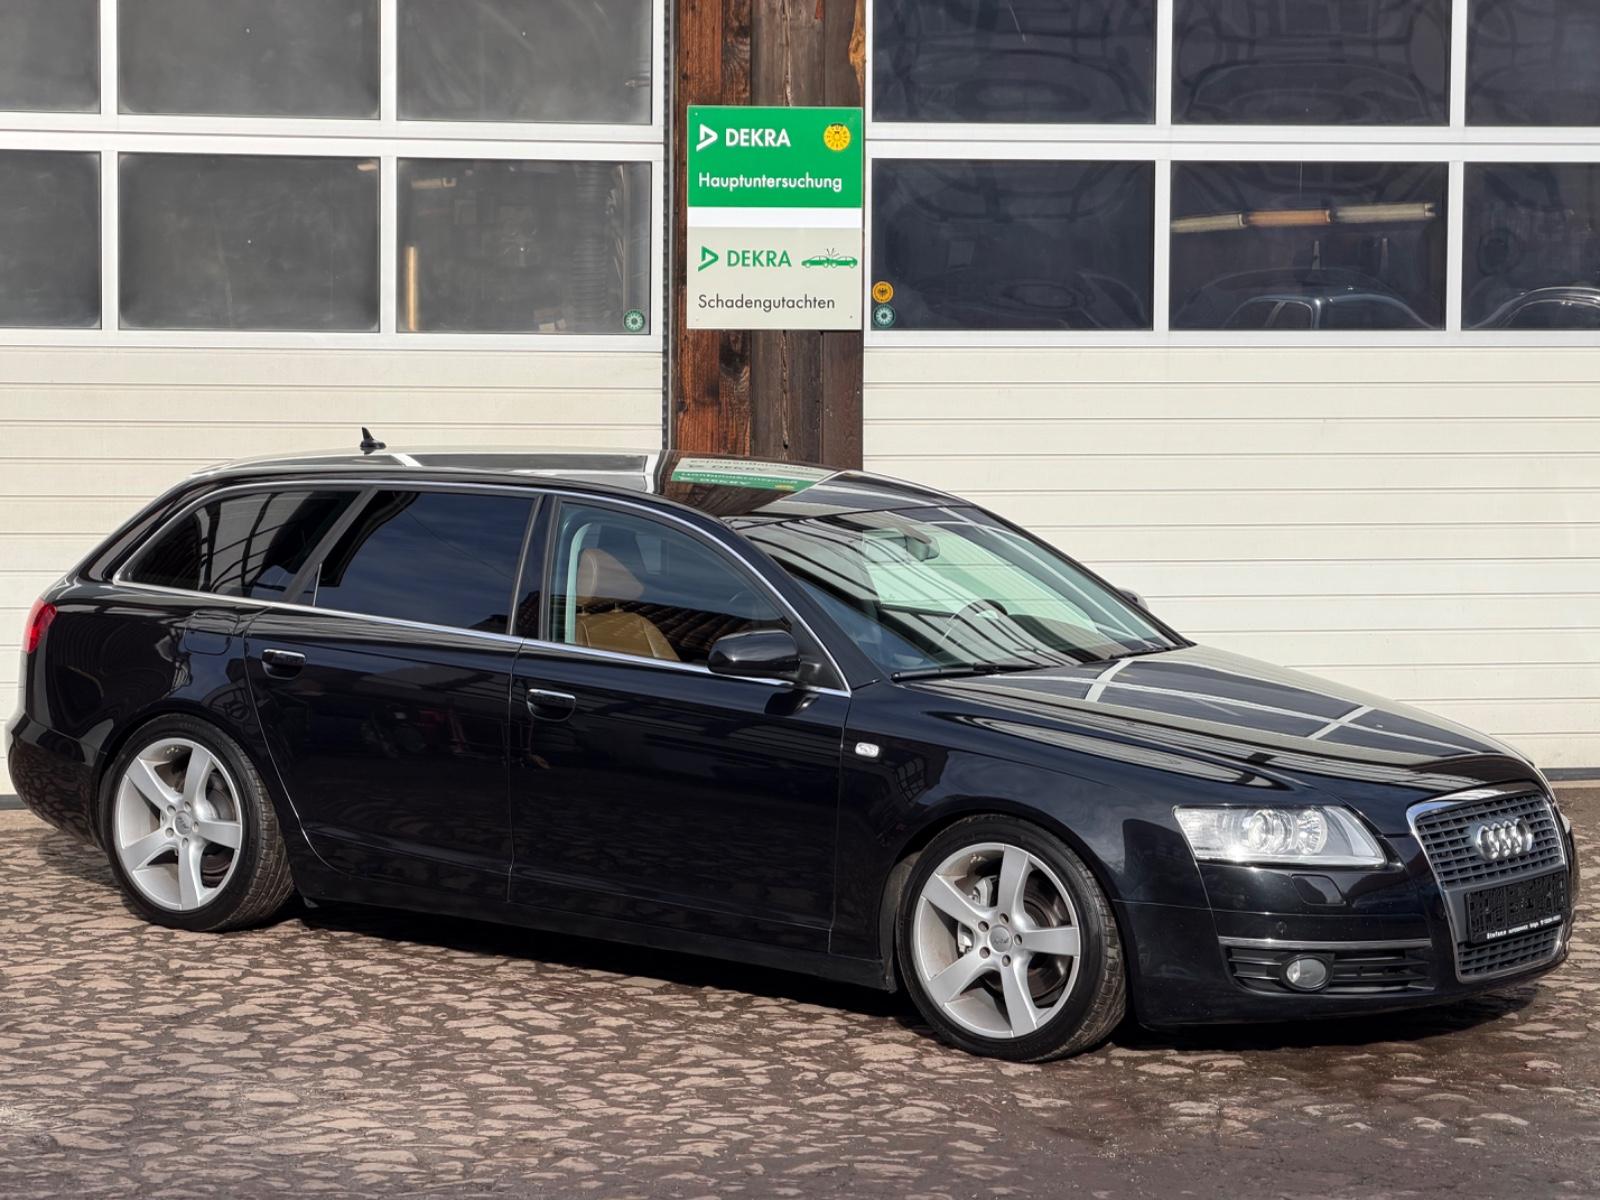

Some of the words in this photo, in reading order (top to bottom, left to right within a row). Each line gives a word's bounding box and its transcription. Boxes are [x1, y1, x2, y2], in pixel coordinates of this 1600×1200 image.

[725, 128, 791, 147] DEKRA
[698, 172, 842, 192] Hauptuntersuchung
[727, 250, 792, 267] DEKRA
[698, 293, 835, 312] Schadengutachten
